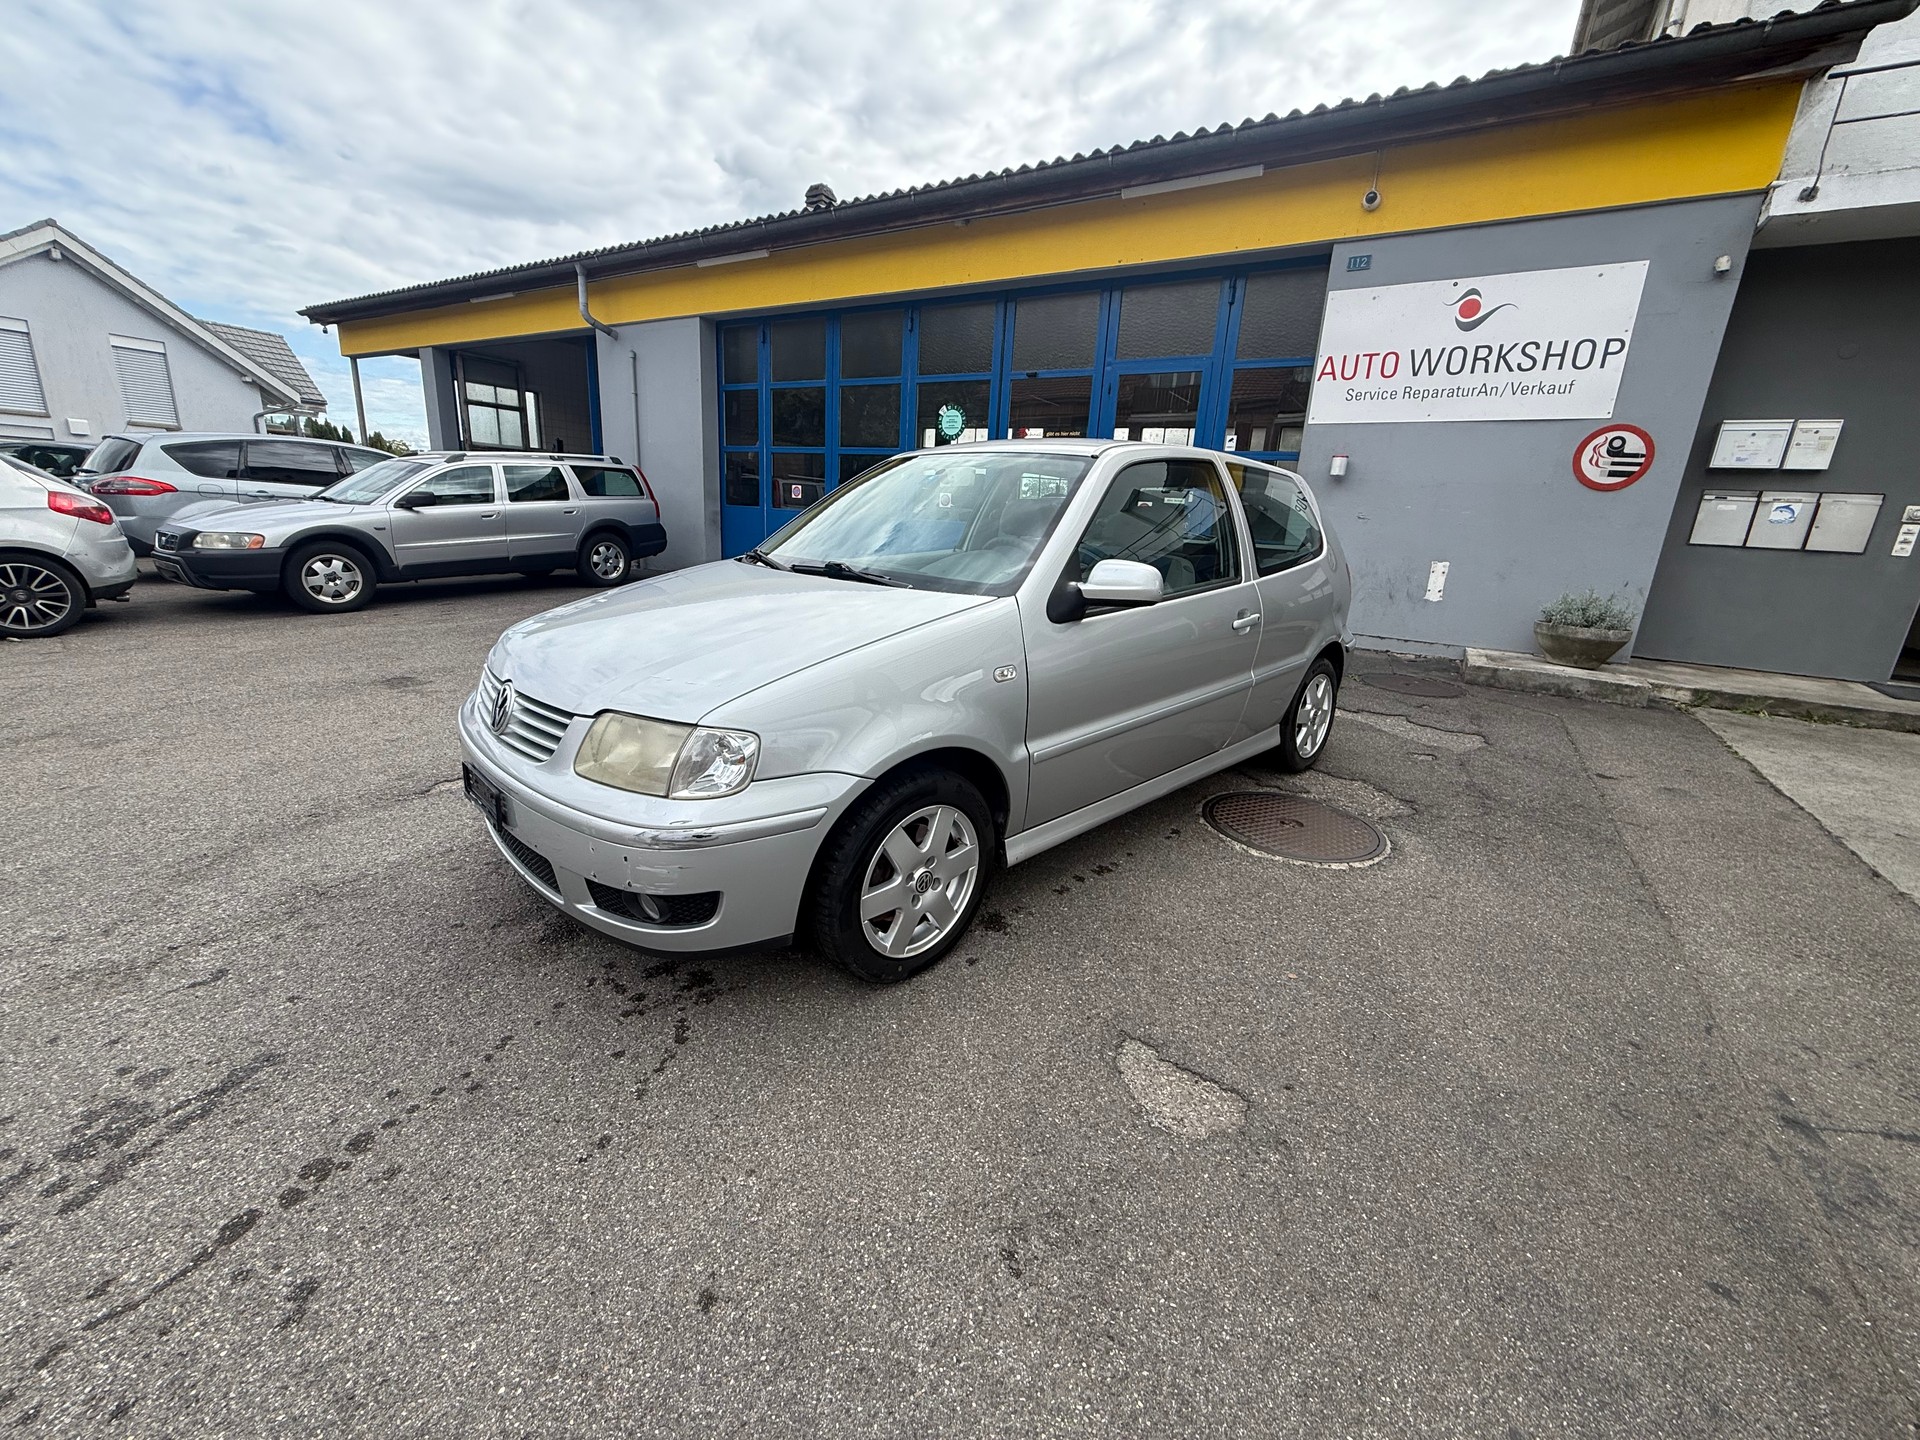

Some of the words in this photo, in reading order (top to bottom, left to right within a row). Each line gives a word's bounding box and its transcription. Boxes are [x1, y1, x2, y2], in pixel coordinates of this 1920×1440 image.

[1350, 257, 1368, 269] 112
[1317, 351, 1400, 382] AUTO
[1410, 338, 1626, 377] WORKSHOP
[1345, 387, 1398, 402] Service
